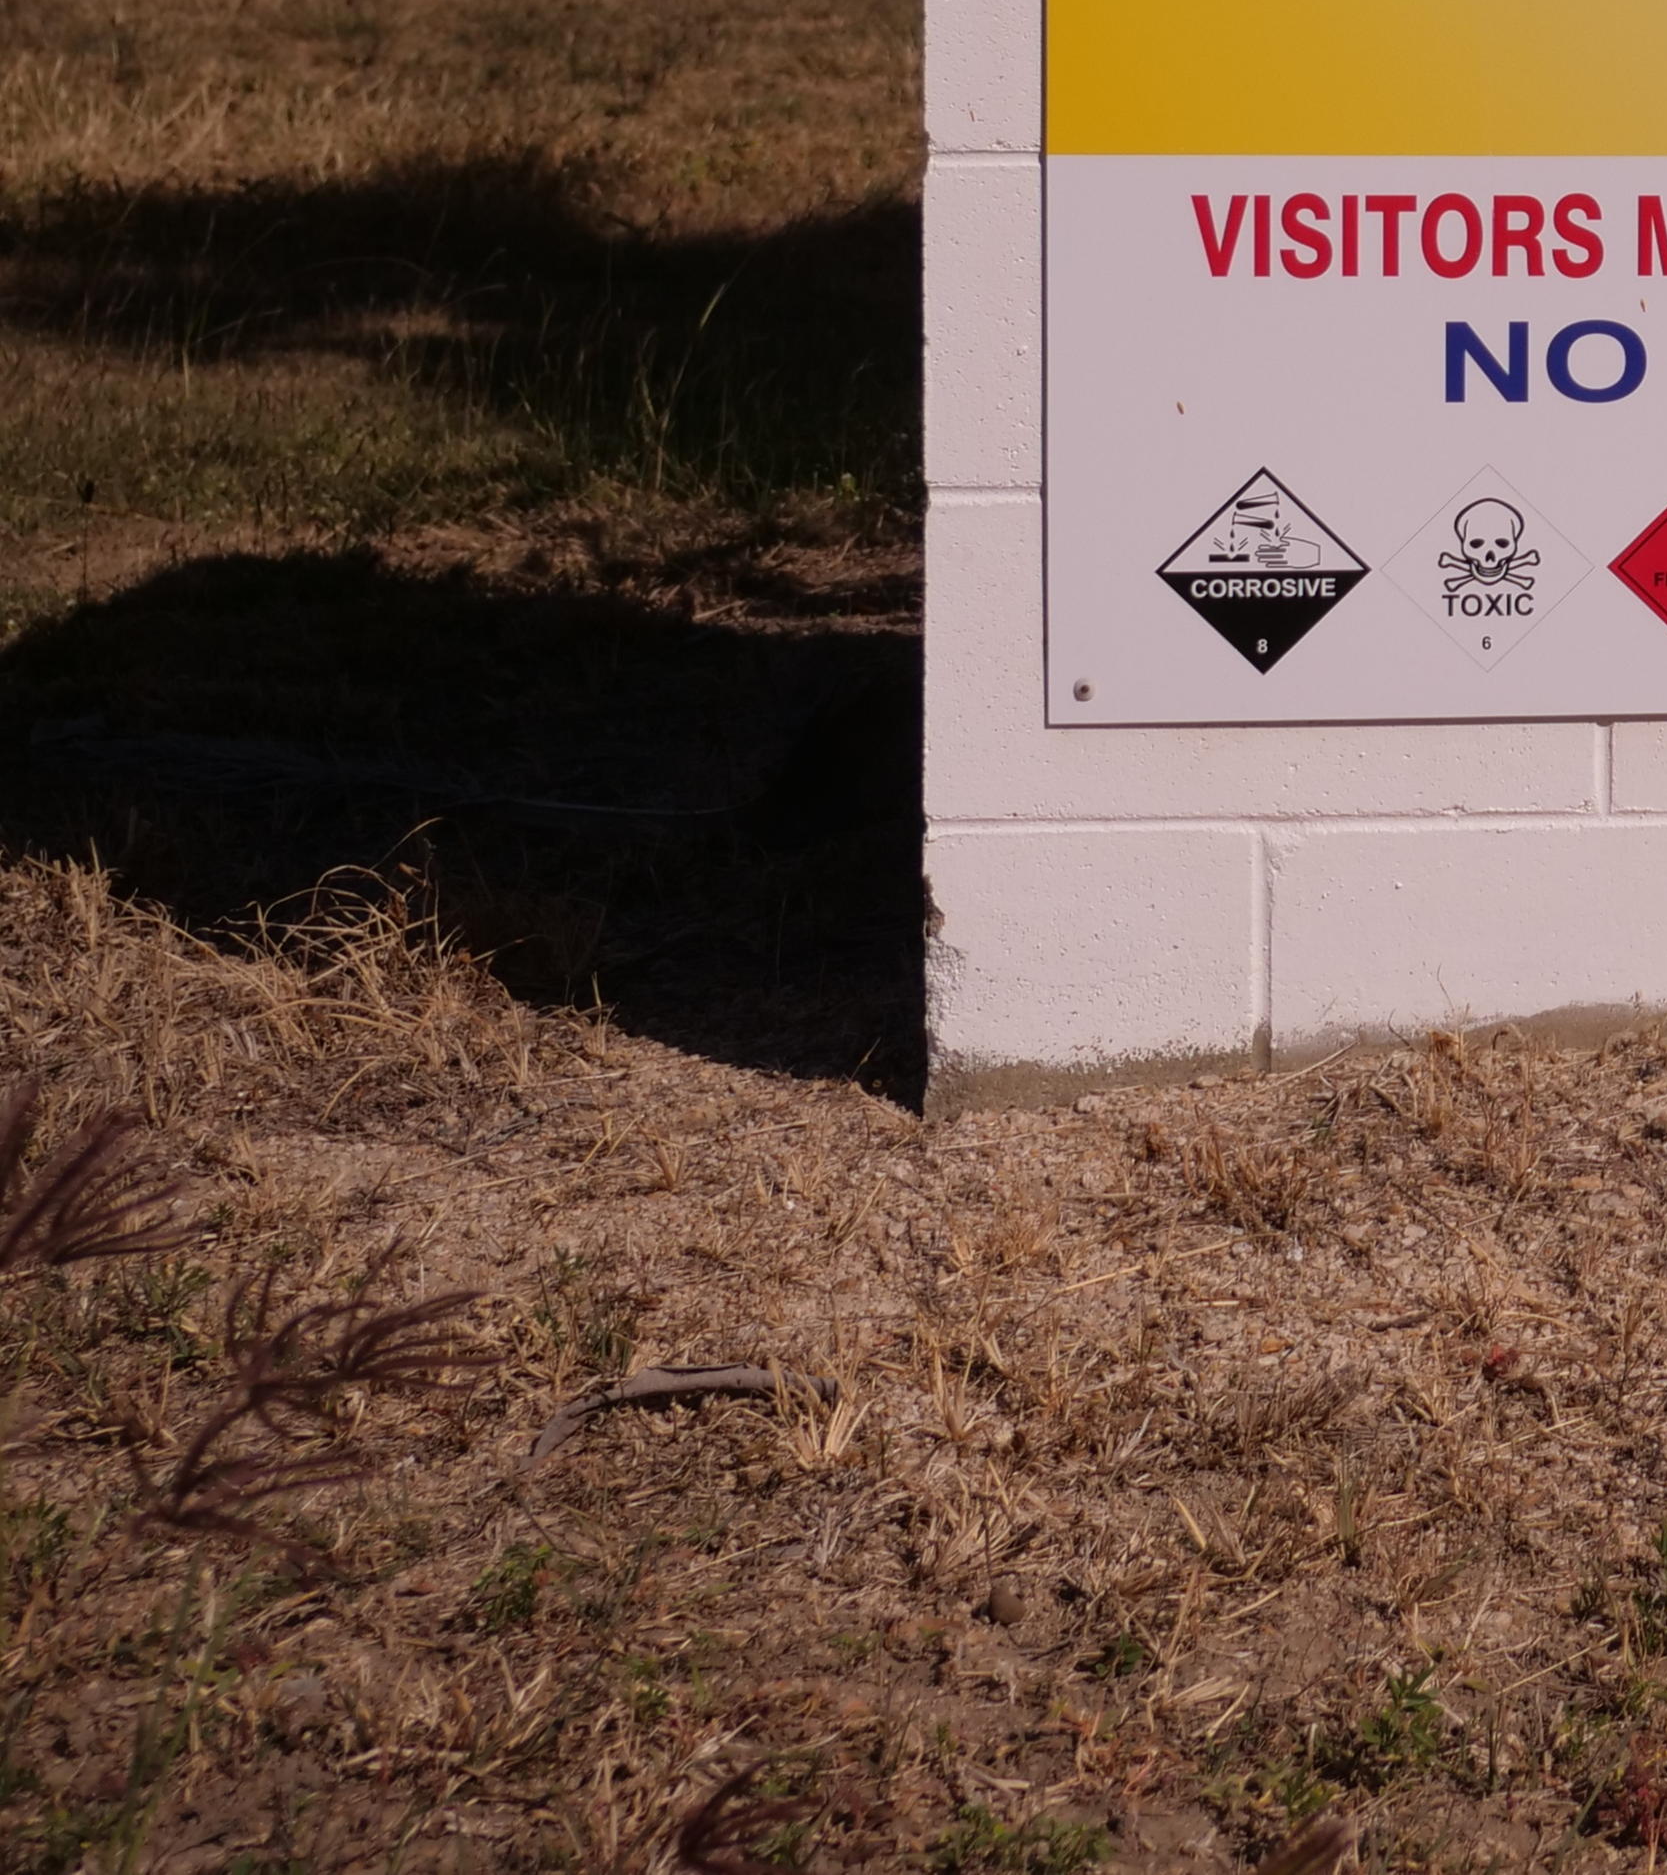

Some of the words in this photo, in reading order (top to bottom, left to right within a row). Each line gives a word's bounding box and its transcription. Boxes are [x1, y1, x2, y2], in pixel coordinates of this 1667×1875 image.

[1191, 192, 1605, 280] VISITORS
[1444, 319, 1648, 403] NO
[1191, 578, 1336, 599] CORROSIVE
[1441, 592, 1534, 618] TOXIC
[1257, 639, 1268, 654] 8
[1481, 636, 1491, 651] 6
